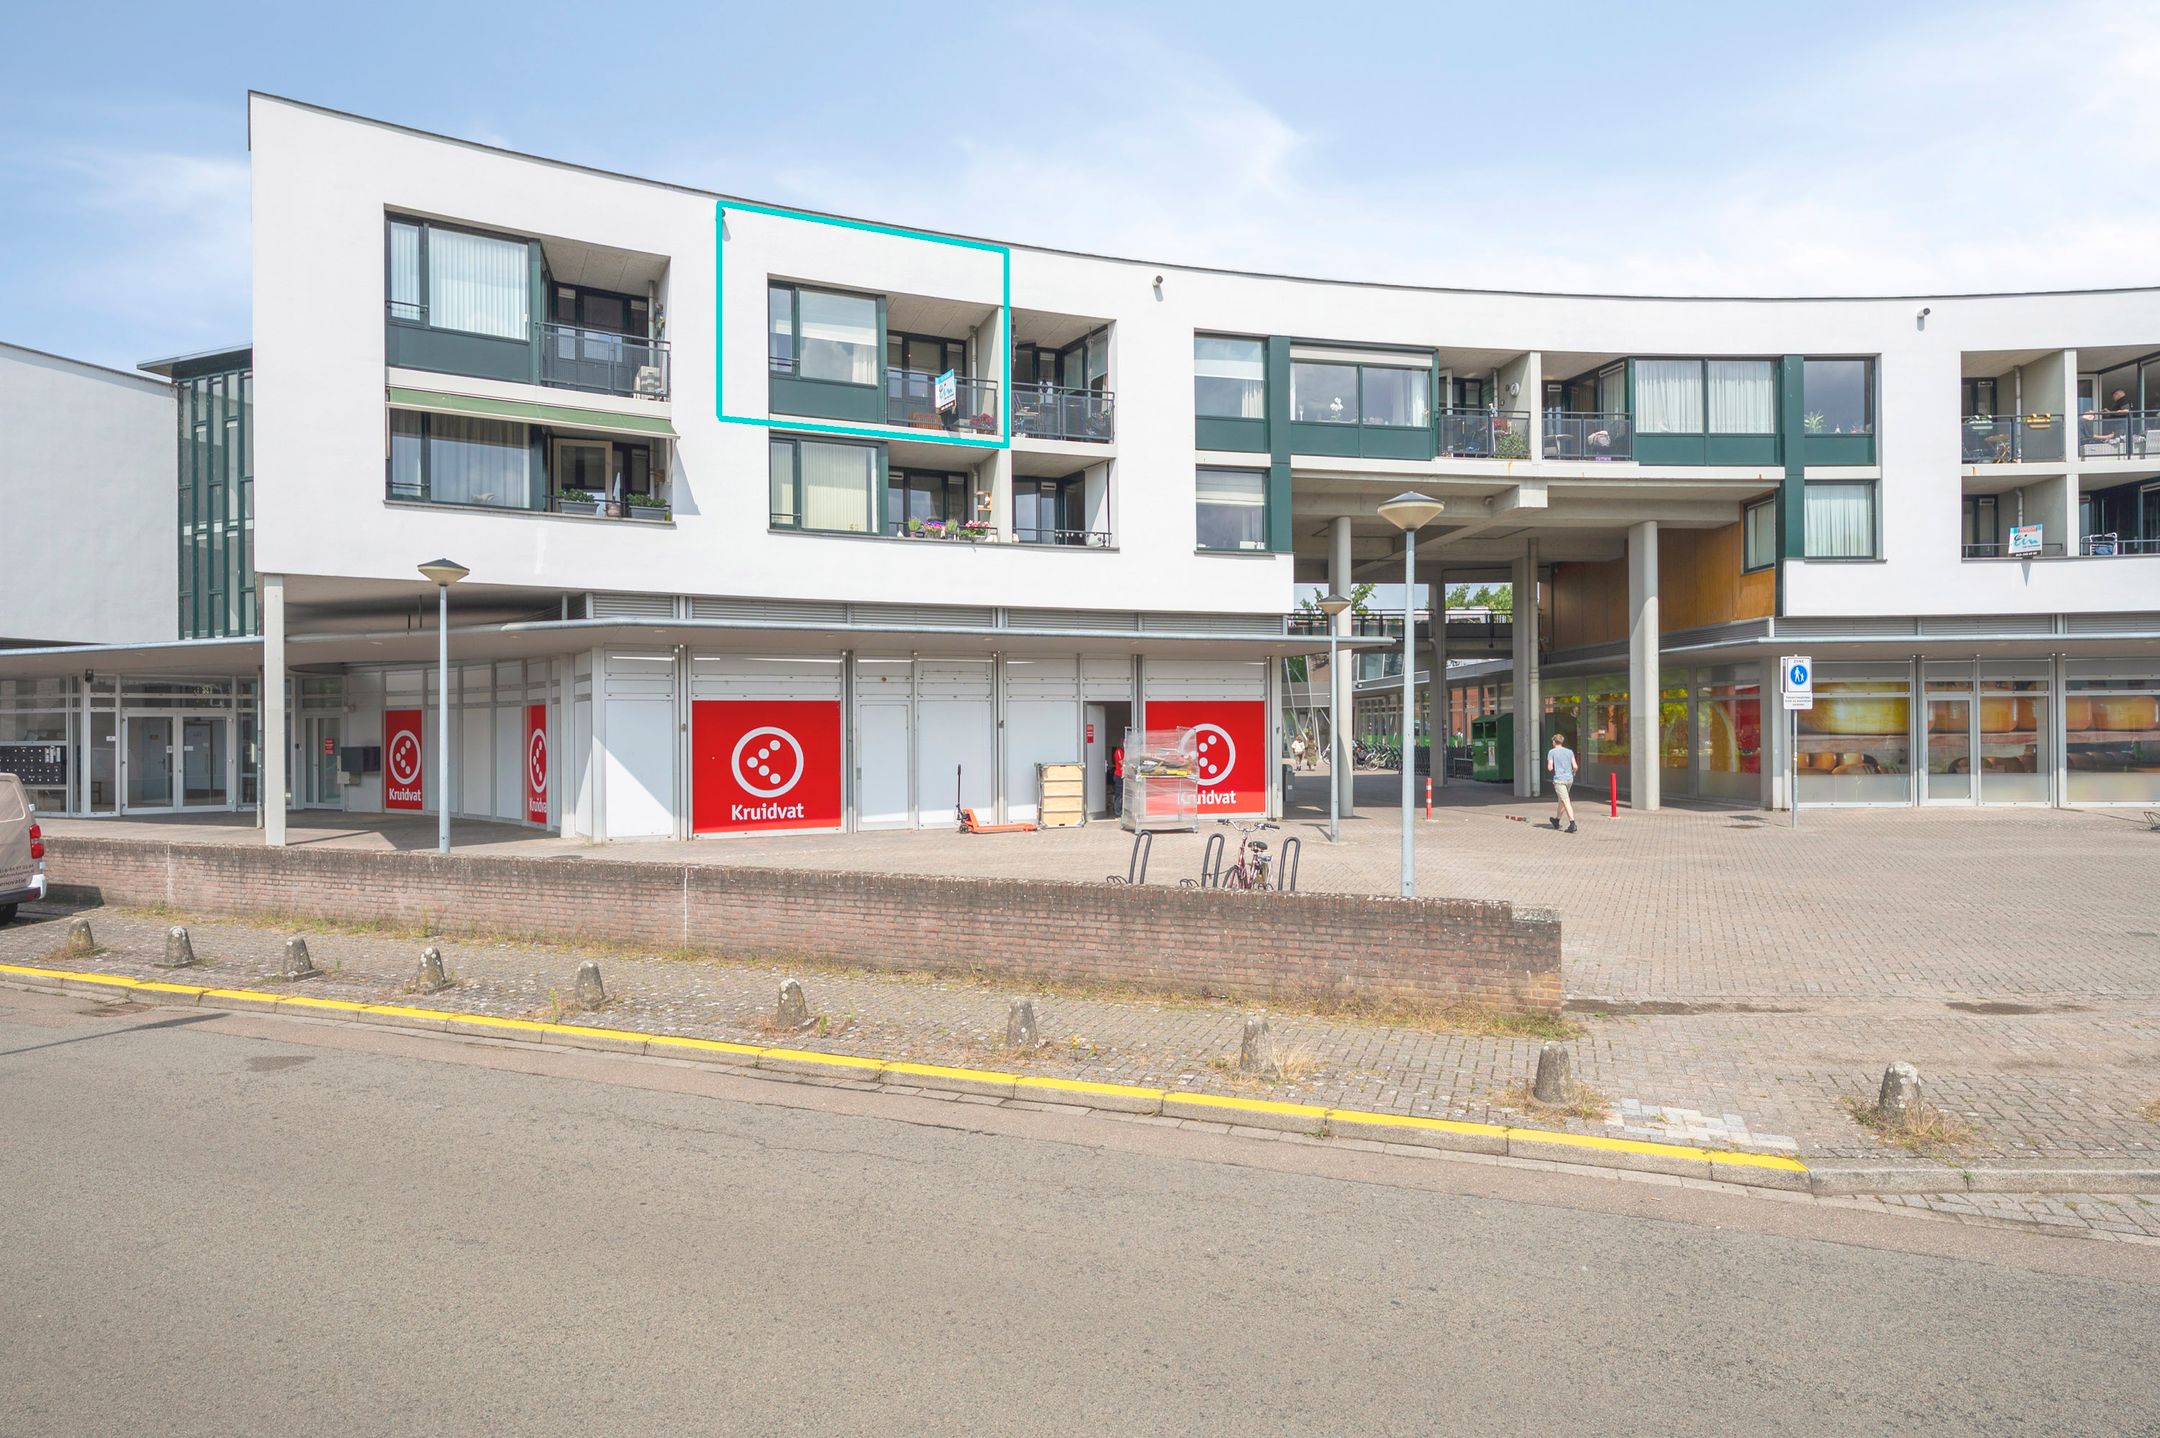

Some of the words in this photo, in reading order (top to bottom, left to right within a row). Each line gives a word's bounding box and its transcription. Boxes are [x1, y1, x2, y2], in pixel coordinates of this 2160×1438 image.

[389, 788, 422, 802] Kruidvat
[1178, 789, 1237, 805] Kuidvat
[528, 797, 547, 813] Kruidva
[731, 802, 804, 821] Kruidvat
